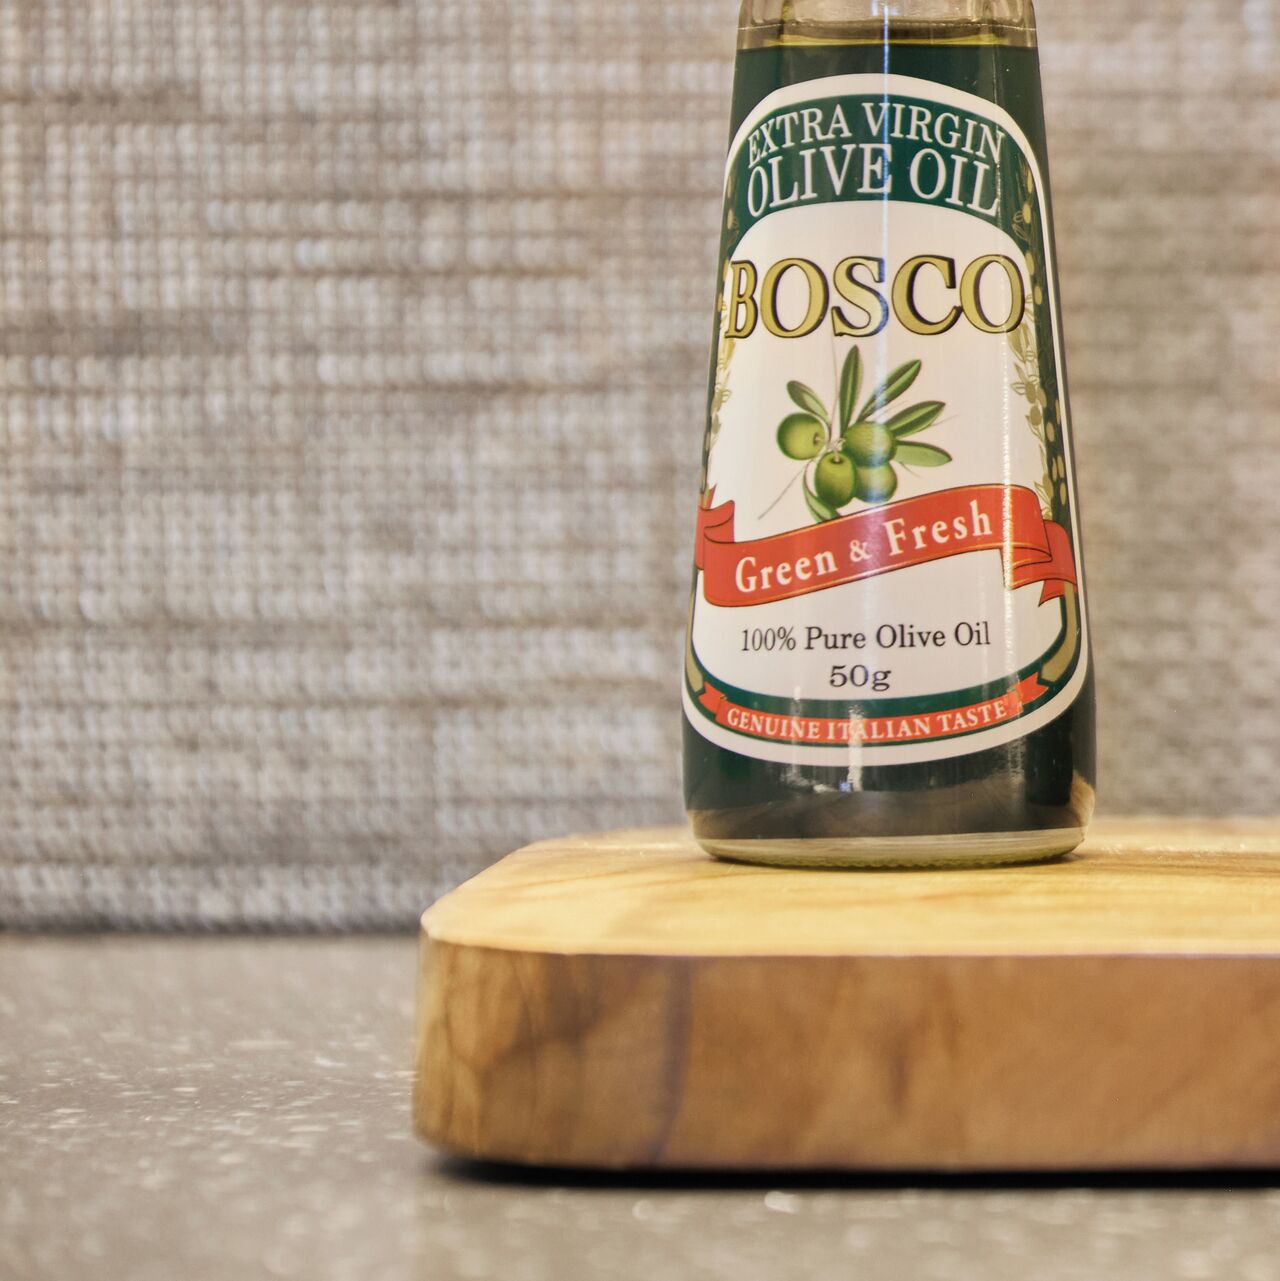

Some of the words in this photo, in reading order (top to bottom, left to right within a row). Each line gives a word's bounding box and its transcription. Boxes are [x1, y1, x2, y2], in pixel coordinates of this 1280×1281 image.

[747, 103, 852, 169] EXTRA
[861, 102, 1006, 165] VIRGIN
[747, 142, 893, 218] OLIVE
[909, 148, 1001, 218] OIL
[724, 254, 1026, 339] BOSCO
[735, 549, 838, 593] Green
[849, 539, 871, 562] &
[883, 499, 992, 557] Fresh
[741, 626, 797, 651] 100%
[804, 625, 866, 651] Pure
[876, 623, 946, 649] Olive
[954, 621, 991, 647] Oil
[829, 664, 892, 691] 50g
[727, 707, 820, 740] GENUINE
[828, 717, 932, 740] ITALIAN
[937, 699, 1008, 732] TASTE
